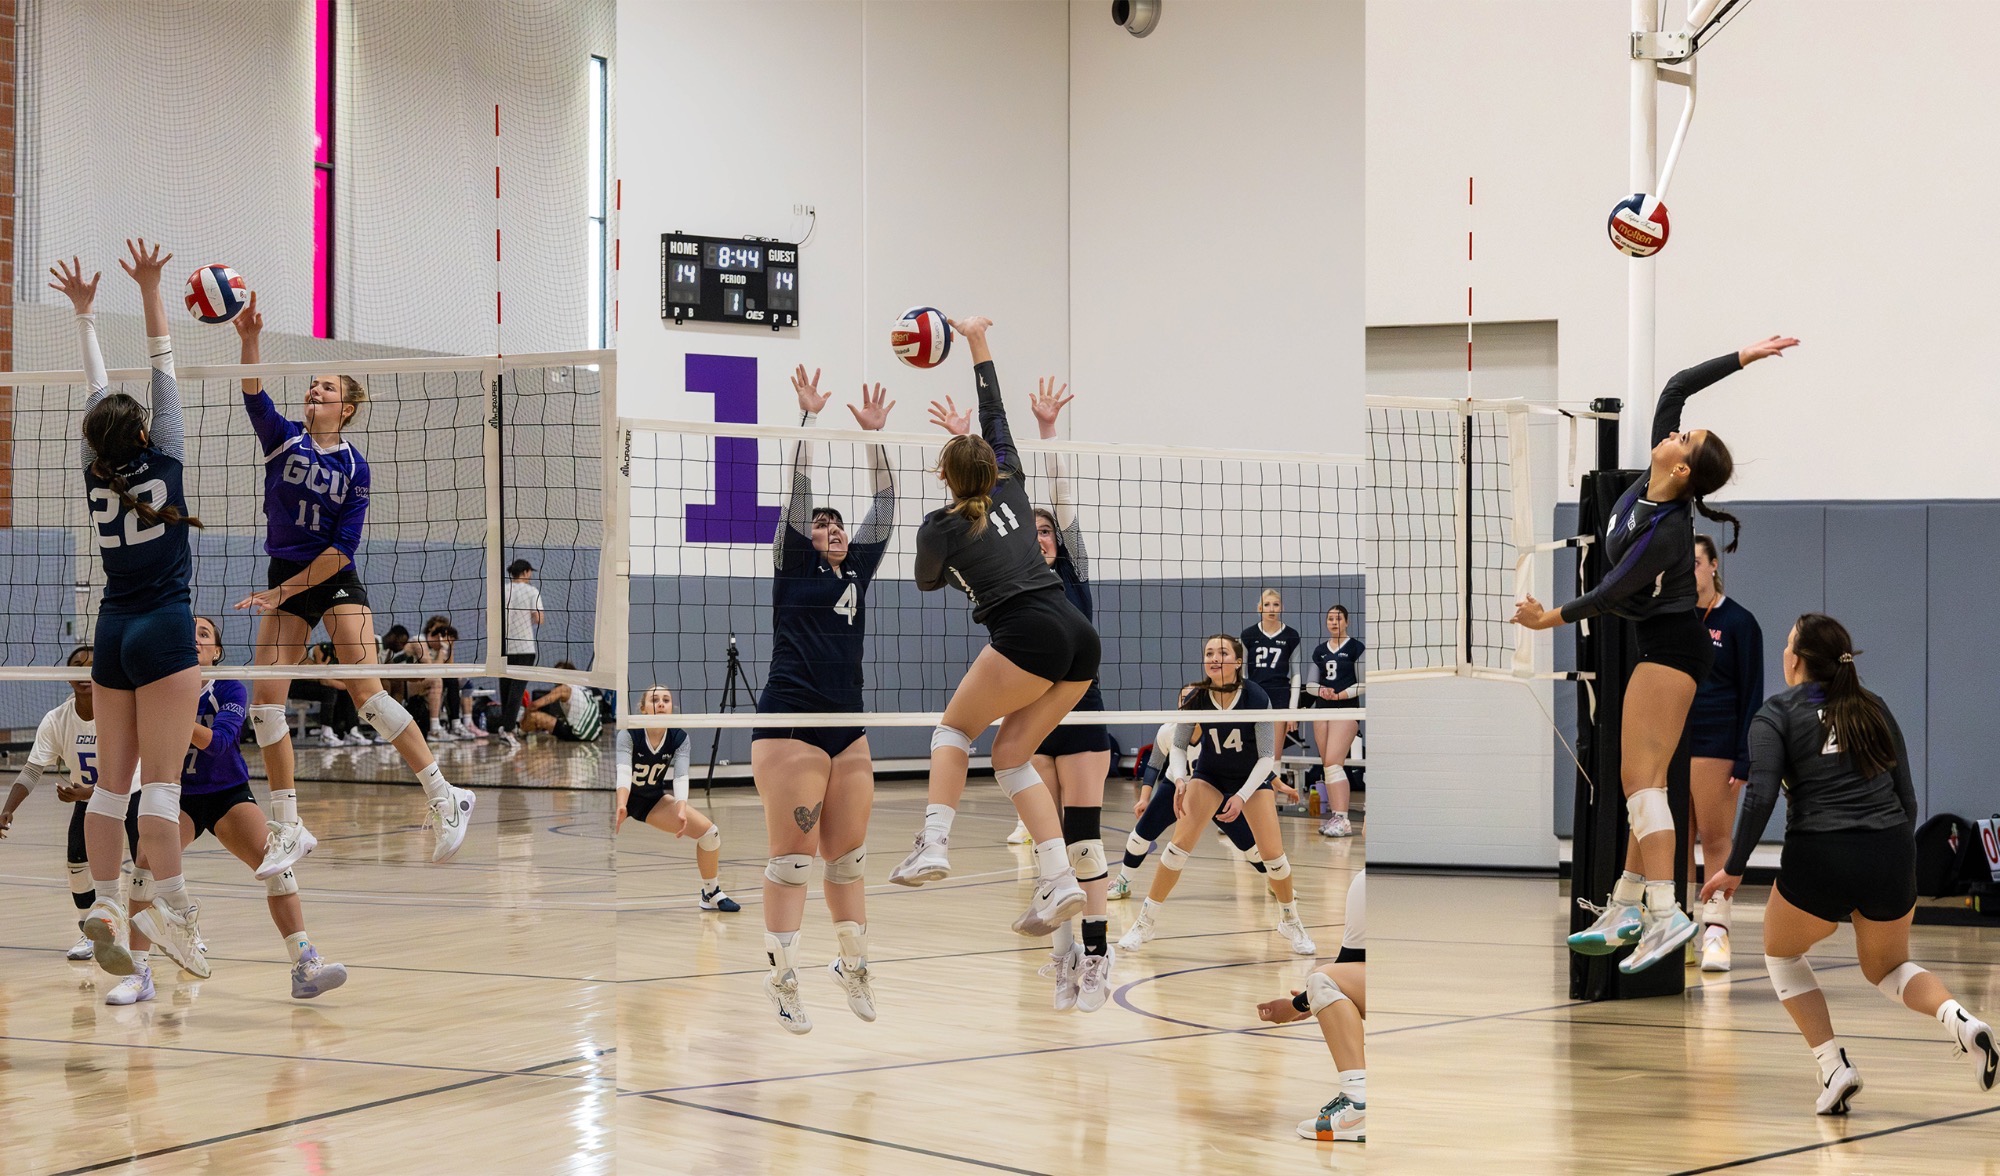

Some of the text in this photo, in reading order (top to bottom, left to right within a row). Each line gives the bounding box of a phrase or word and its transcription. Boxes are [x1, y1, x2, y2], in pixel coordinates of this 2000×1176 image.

[1618, 224, 1653, 245] molten
[670, 241, 698, 255] HOME
[719, 246, 760, 269] 8:44
[768, 249, 796, 263] GUEST
[677, 264, 696, 284] 14
[720, 274, 747, 285] PERIOD
[776, 271, 793, 290] 14
[674, 307, 694, 317] P B
[733, 293, 739, 311] 1
[745, 310, 765, 320] OES
[773, 314, 792, 324] P B
[685, 353, 782, 543] 1
[283, 454, 350, 504] GCU
[90, 479, 167, 549] 22
[295, 500, 320, 531] 11
[990, 502, 1020, 537] 11
[833, 583, 857, 626] 4
[1255, 646, 1282, 669] 27
[1325, 660, 1337, 681] 8
[76, 735, 97, 744] GCU
[1209, 728, 1243, 754] 14
[77, 752, 98, 784] 5
